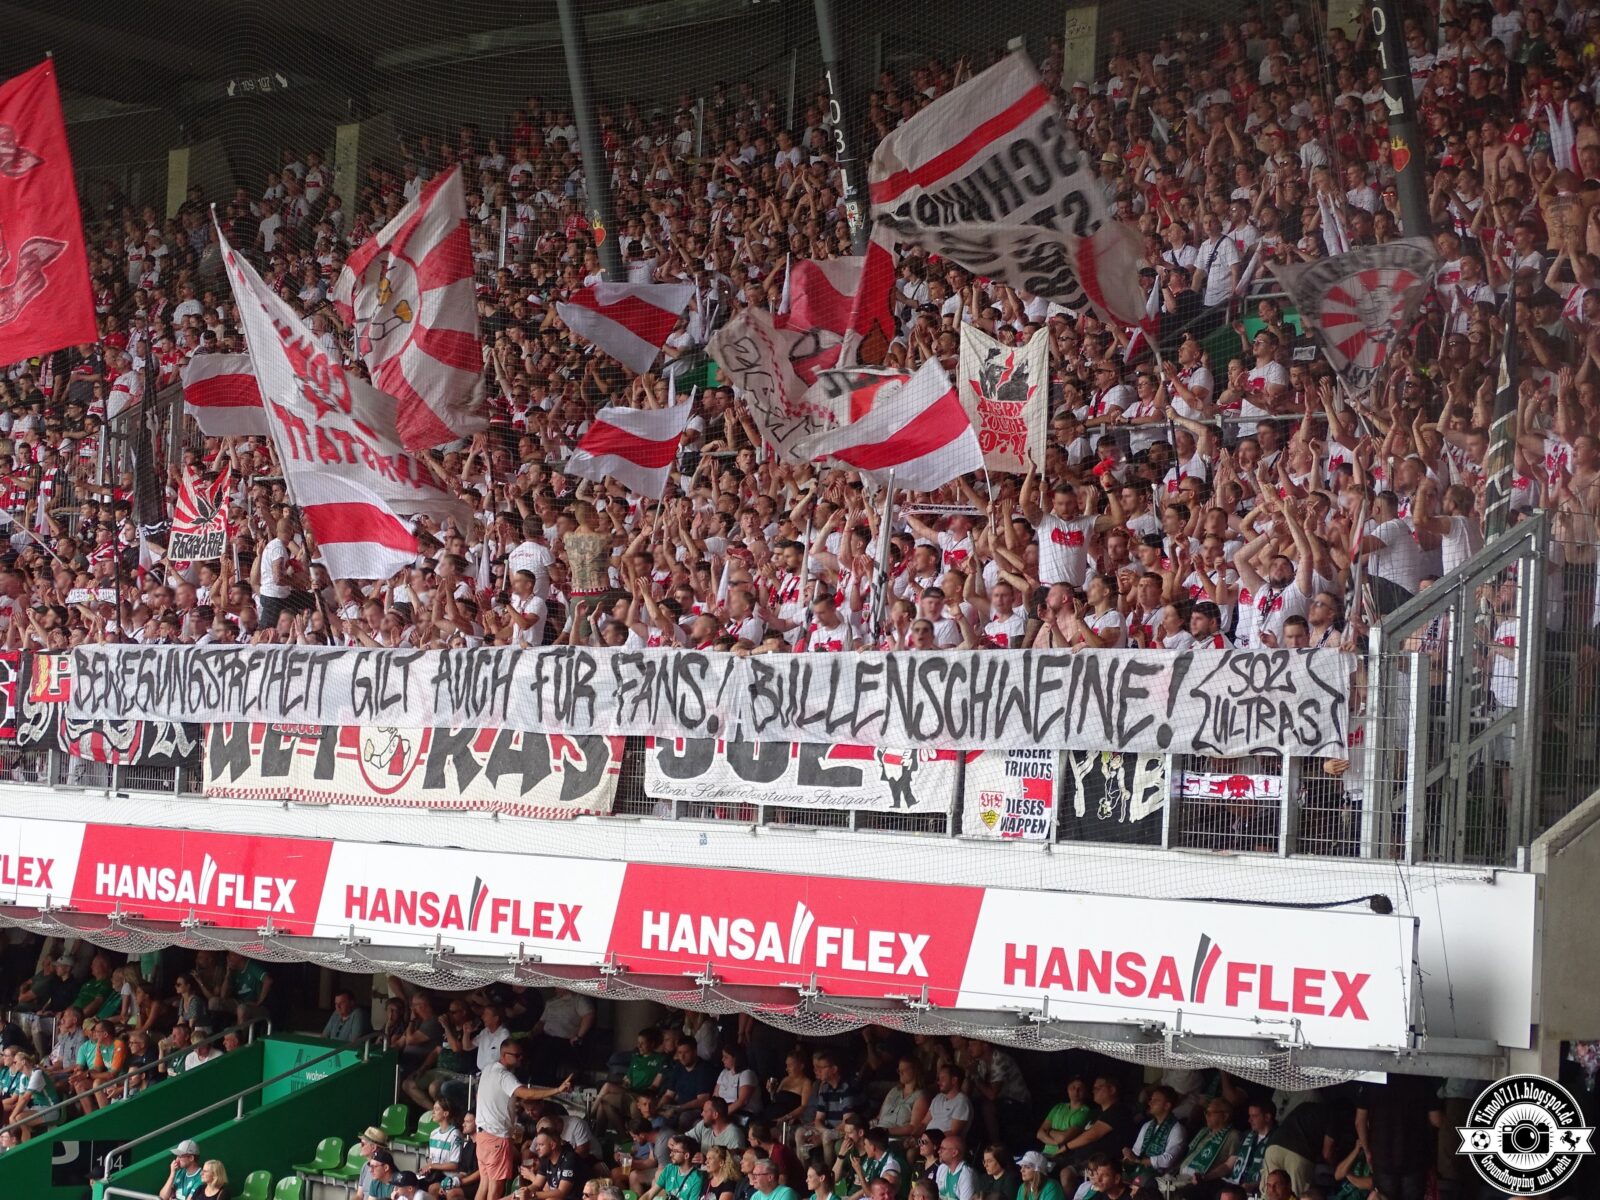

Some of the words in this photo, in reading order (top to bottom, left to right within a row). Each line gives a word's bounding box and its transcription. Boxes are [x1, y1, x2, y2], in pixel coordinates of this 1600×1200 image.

[1371, 0, 1387, 70] 01
[825, 70, 846, 154] 103
[977, 398, 1028, 417] ANGRY
[978, 412, 1028, 433] YOUTH
[171, 541, 223, 559] KOMPANIE
[174, 530, 225, 547] SCHWABEN
[351, 649, 426, 721] GILT
[431, 647, 523, 722] AUCH
[530, 646, 597, 727] FÜR
[612, 651, 735, 735] FANS!
[748, 650, 1194, 748] BULLENSCHWEINE!
[1213, 695, 1322, 747] ULTRAS
[1005, 760, 1053, 779] TRIKOTS
[1000, 817, 1047, 834] WAPPEN
[0, 854, 54, 889] LEX
[95, 862, 197, 904] HANSA
[217, 873, 297, 914] FLEX
[344, 884, 465, 931] HANSA
[490, 897, 583, 942] FLEX
[641, 910, 786, 964] HANSA
[815, 925, 931, 978] FLEX
[1003, 942, 1185, 1002] HANSA
[1225, 961, 1371, 1021] FLEX
